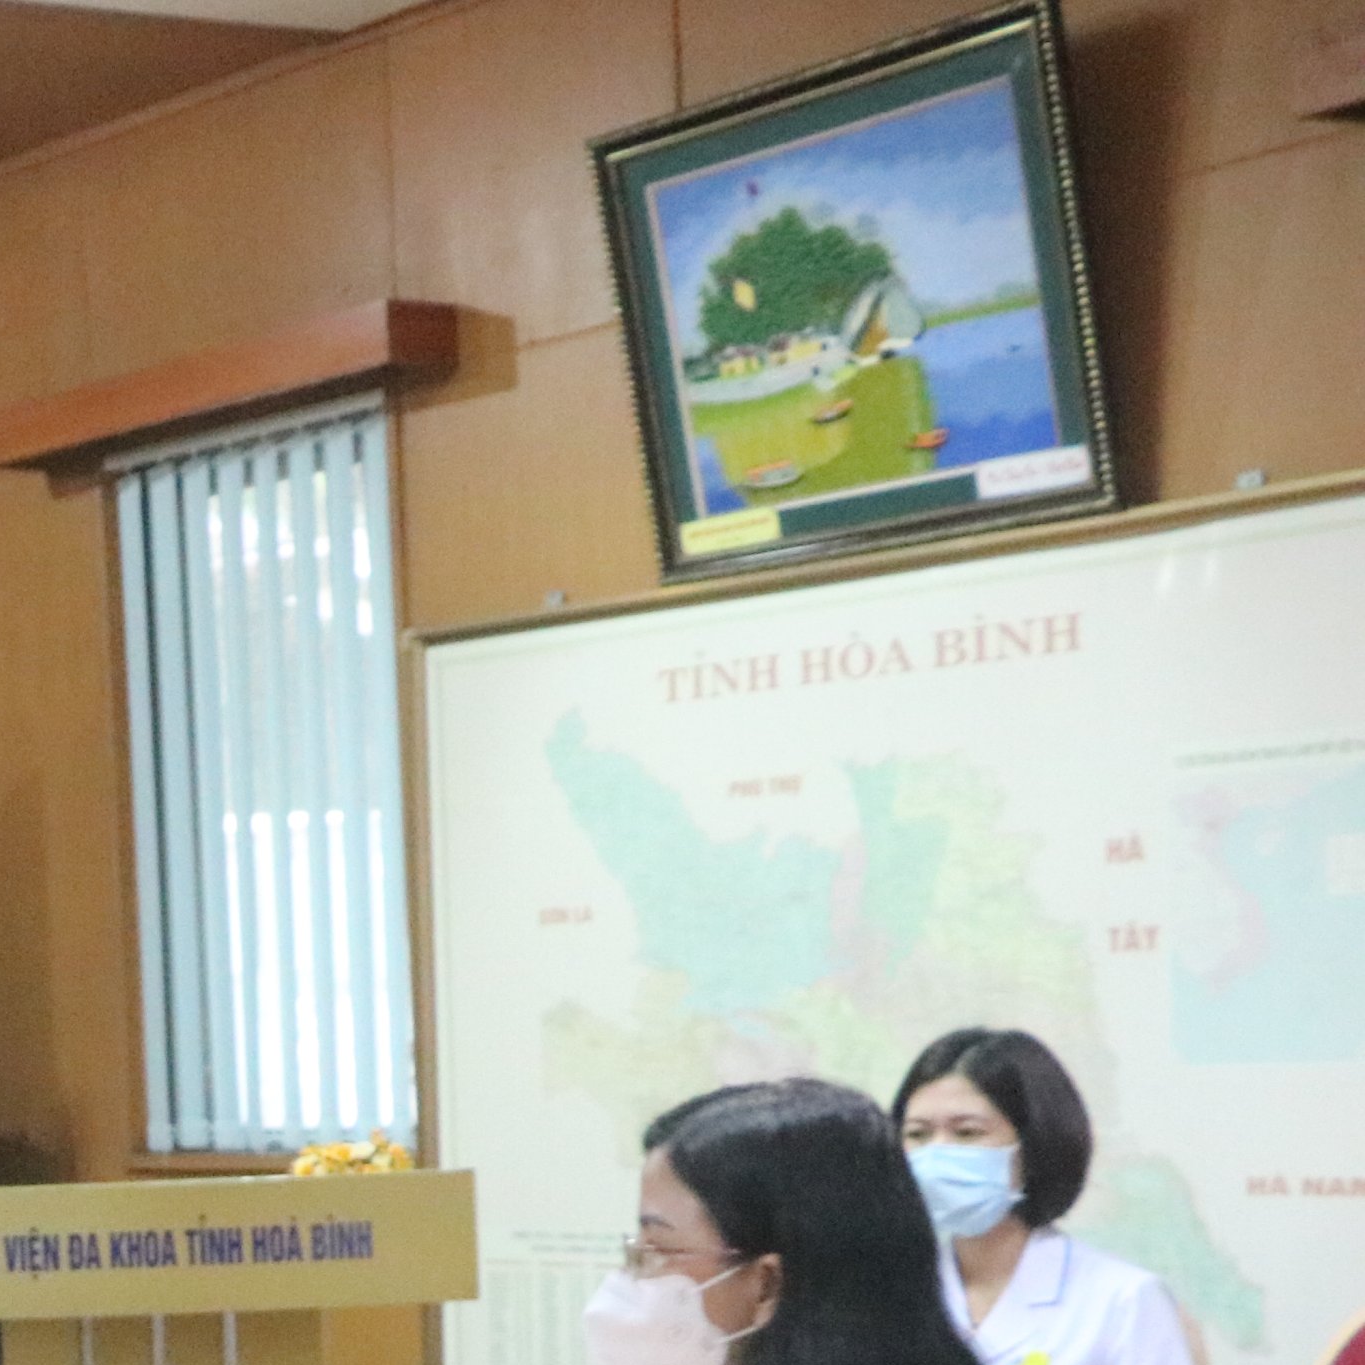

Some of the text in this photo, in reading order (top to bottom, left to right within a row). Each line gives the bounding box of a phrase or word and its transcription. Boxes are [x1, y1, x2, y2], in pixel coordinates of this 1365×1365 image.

[934, 612, 1081, 668] BÌNH
[4, 1226, 60, 1280] VIỆN
[68, 1232, 101, 1270] ĐA
[110, 1229, 177, 1268] KHOA
[185, 1213, 244, 1265] TỈNH
[311, 1213, 373, 1261] BÌNH
